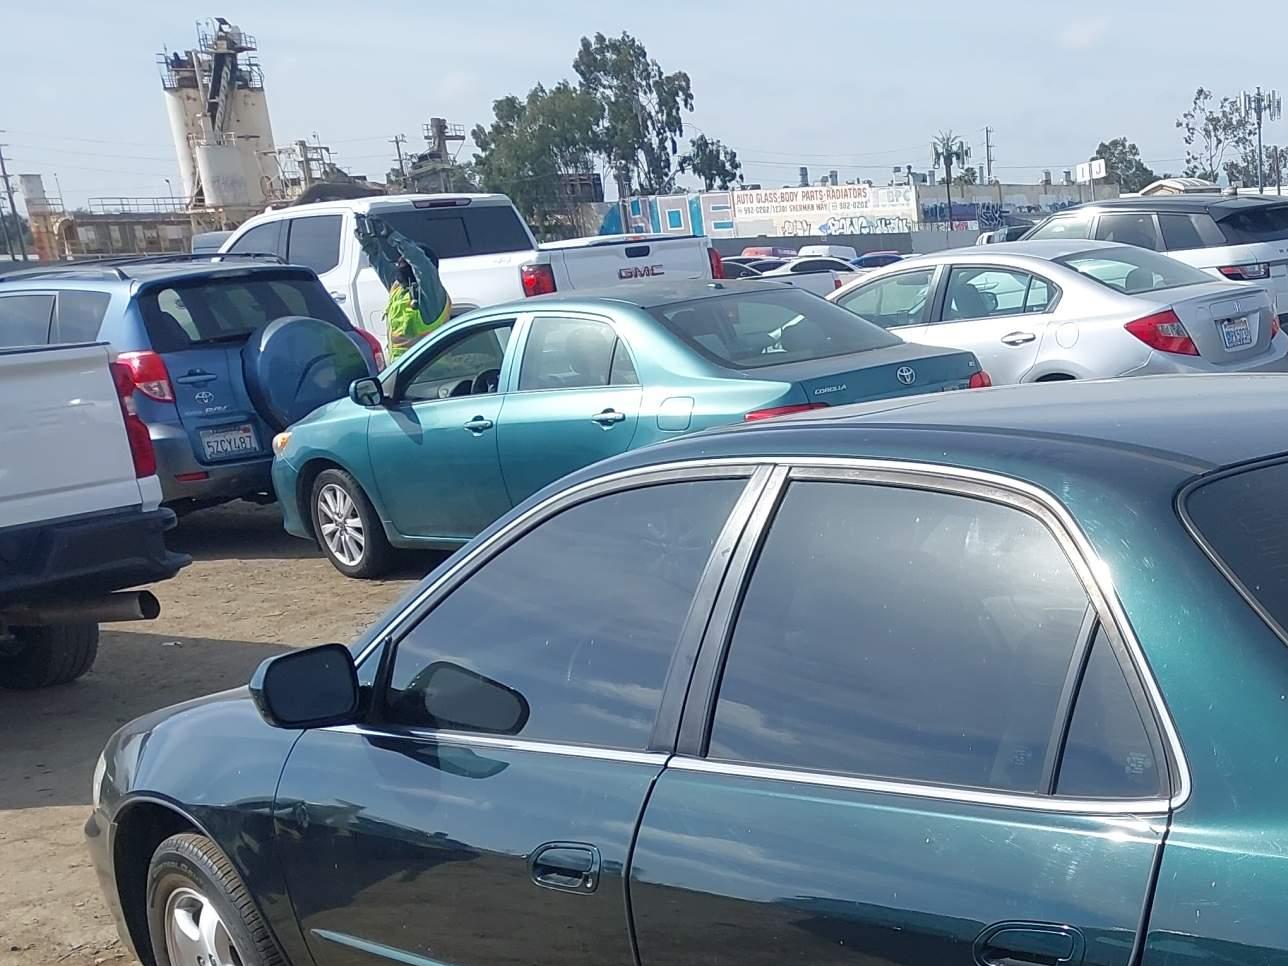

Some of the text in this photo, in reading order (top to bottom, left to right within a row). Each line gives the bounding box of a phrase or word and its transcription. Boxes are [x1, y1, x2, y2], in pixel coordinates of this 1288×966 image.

[736, 193, 754, 205] AUTO
[618, 264, 665, 279] GMC
[814, 384, 847, 395] COROLLA
